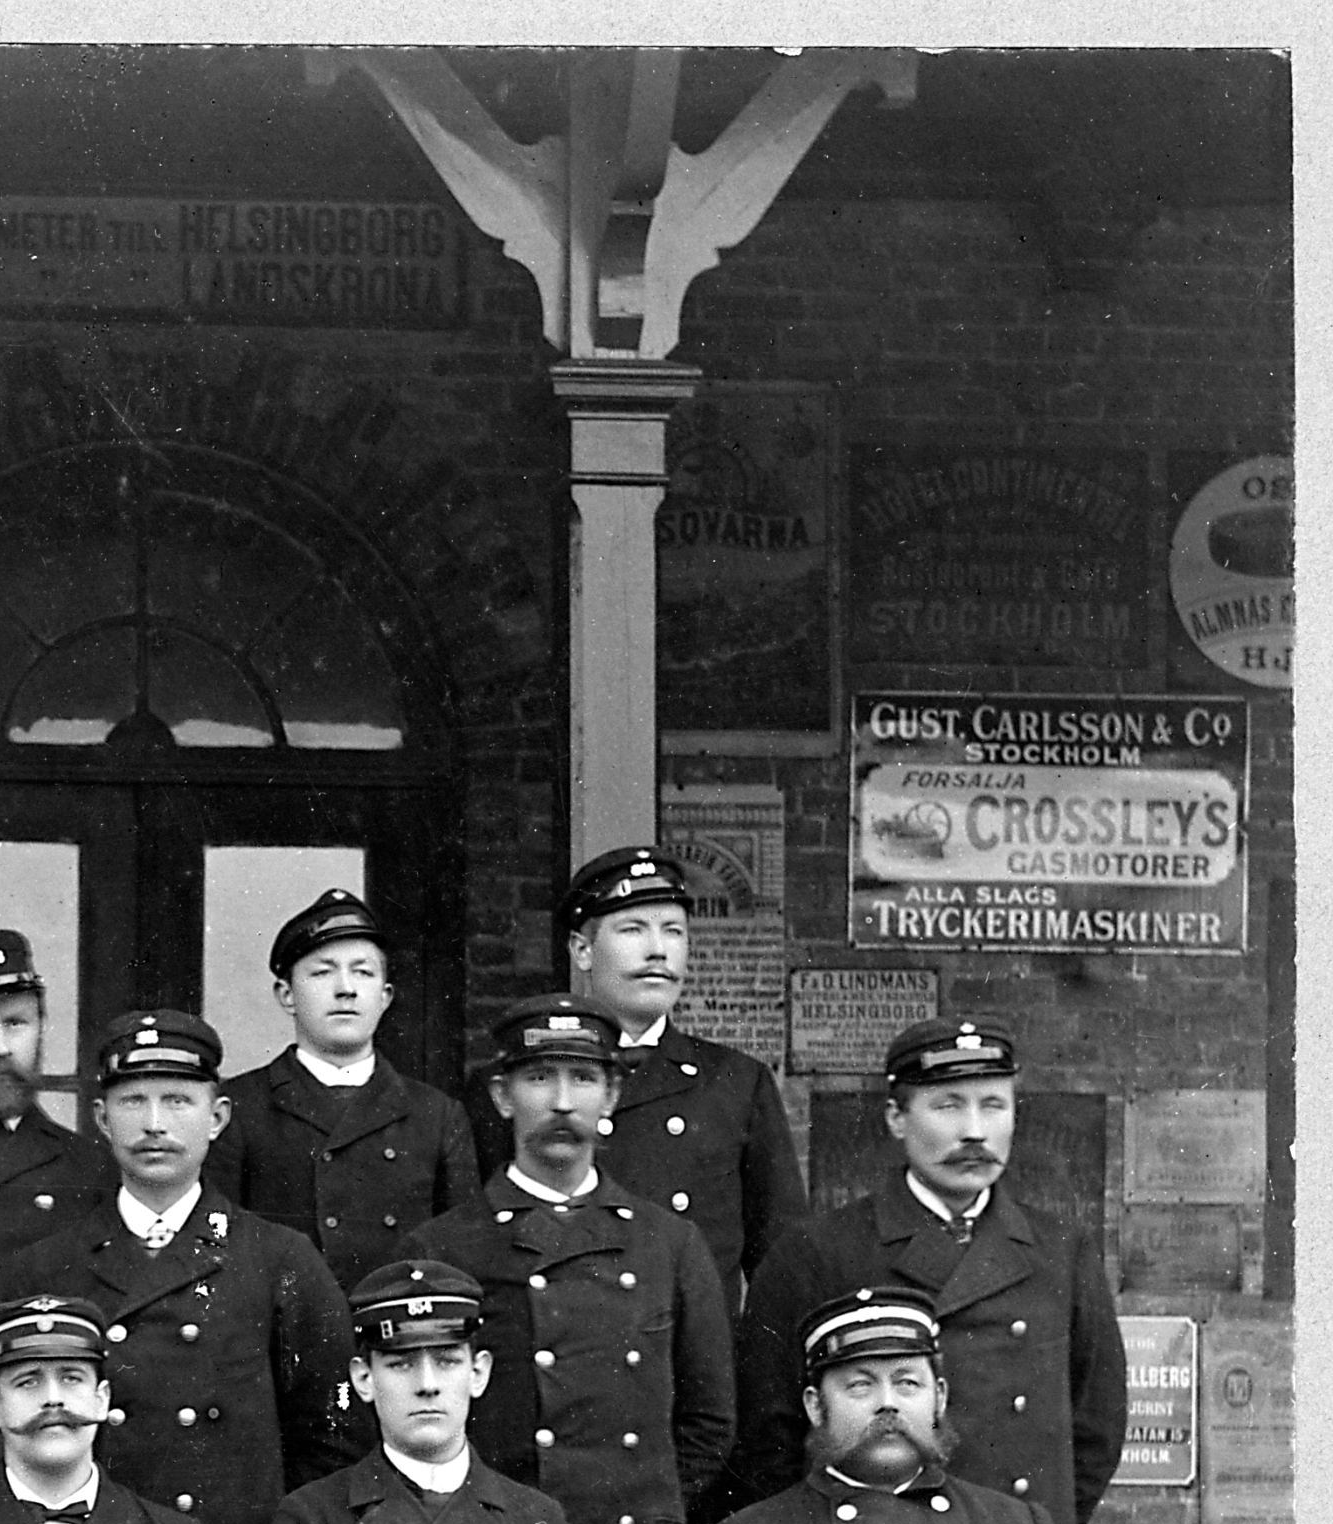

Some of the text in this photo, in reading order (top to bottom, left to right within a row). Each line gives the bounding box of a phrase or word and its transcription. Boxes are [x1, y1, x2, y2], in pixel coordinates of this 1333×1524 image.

[179, 202, 446, 259] HELSINGBORG
[866, 600, 1132, 640] STOCKHOLM
[870, 702, 966, 740] GUST.
[972, 704, 1144, 744] CARLSSON
[1151, 714, 1172, 745] &
[964, 742, 1141, 766] STOCKHOLM
[1006, 850, 1210, 879] GASMOTORER
[904, 886, 1058, 905] ALLA SLAGS
[872, 900, 1223, 943] TRYCKERIMASKINER
[839, 973, 929, 990] LINDMANS
[802, 1004, 927, 1020] HELSINGBORG
